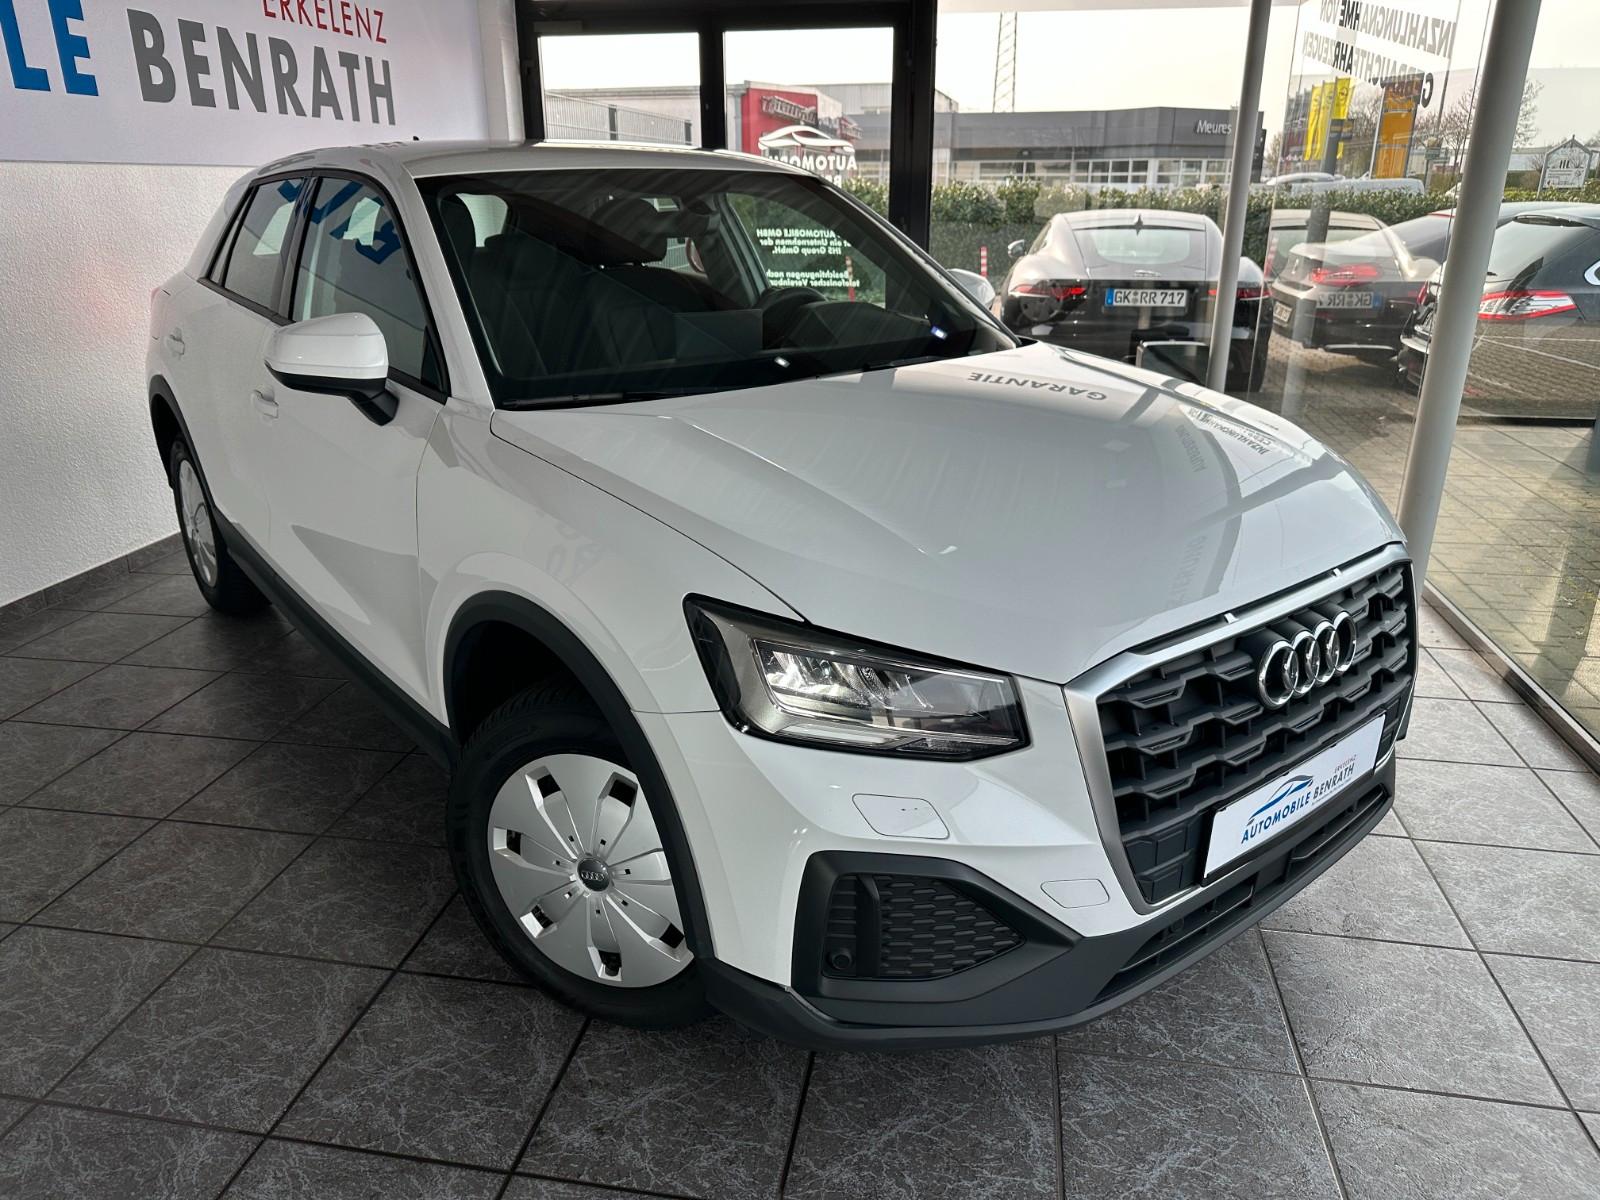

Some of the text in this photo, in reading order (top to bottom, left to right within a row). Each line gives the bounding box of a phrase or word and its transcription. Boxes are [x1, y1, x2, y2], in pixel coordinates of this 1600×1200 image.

[127, 8, 395, 125] BENRATH
[1197, 120, 1232, 134] Meures
[1114, 289, 1185, 305] GK RR 717
[967, 372, 1107, 401] GARANTIE
[1241, 791, 1312, 844] AUTOMOBILE
[1313, 762, 1355, 799] BENRATH
